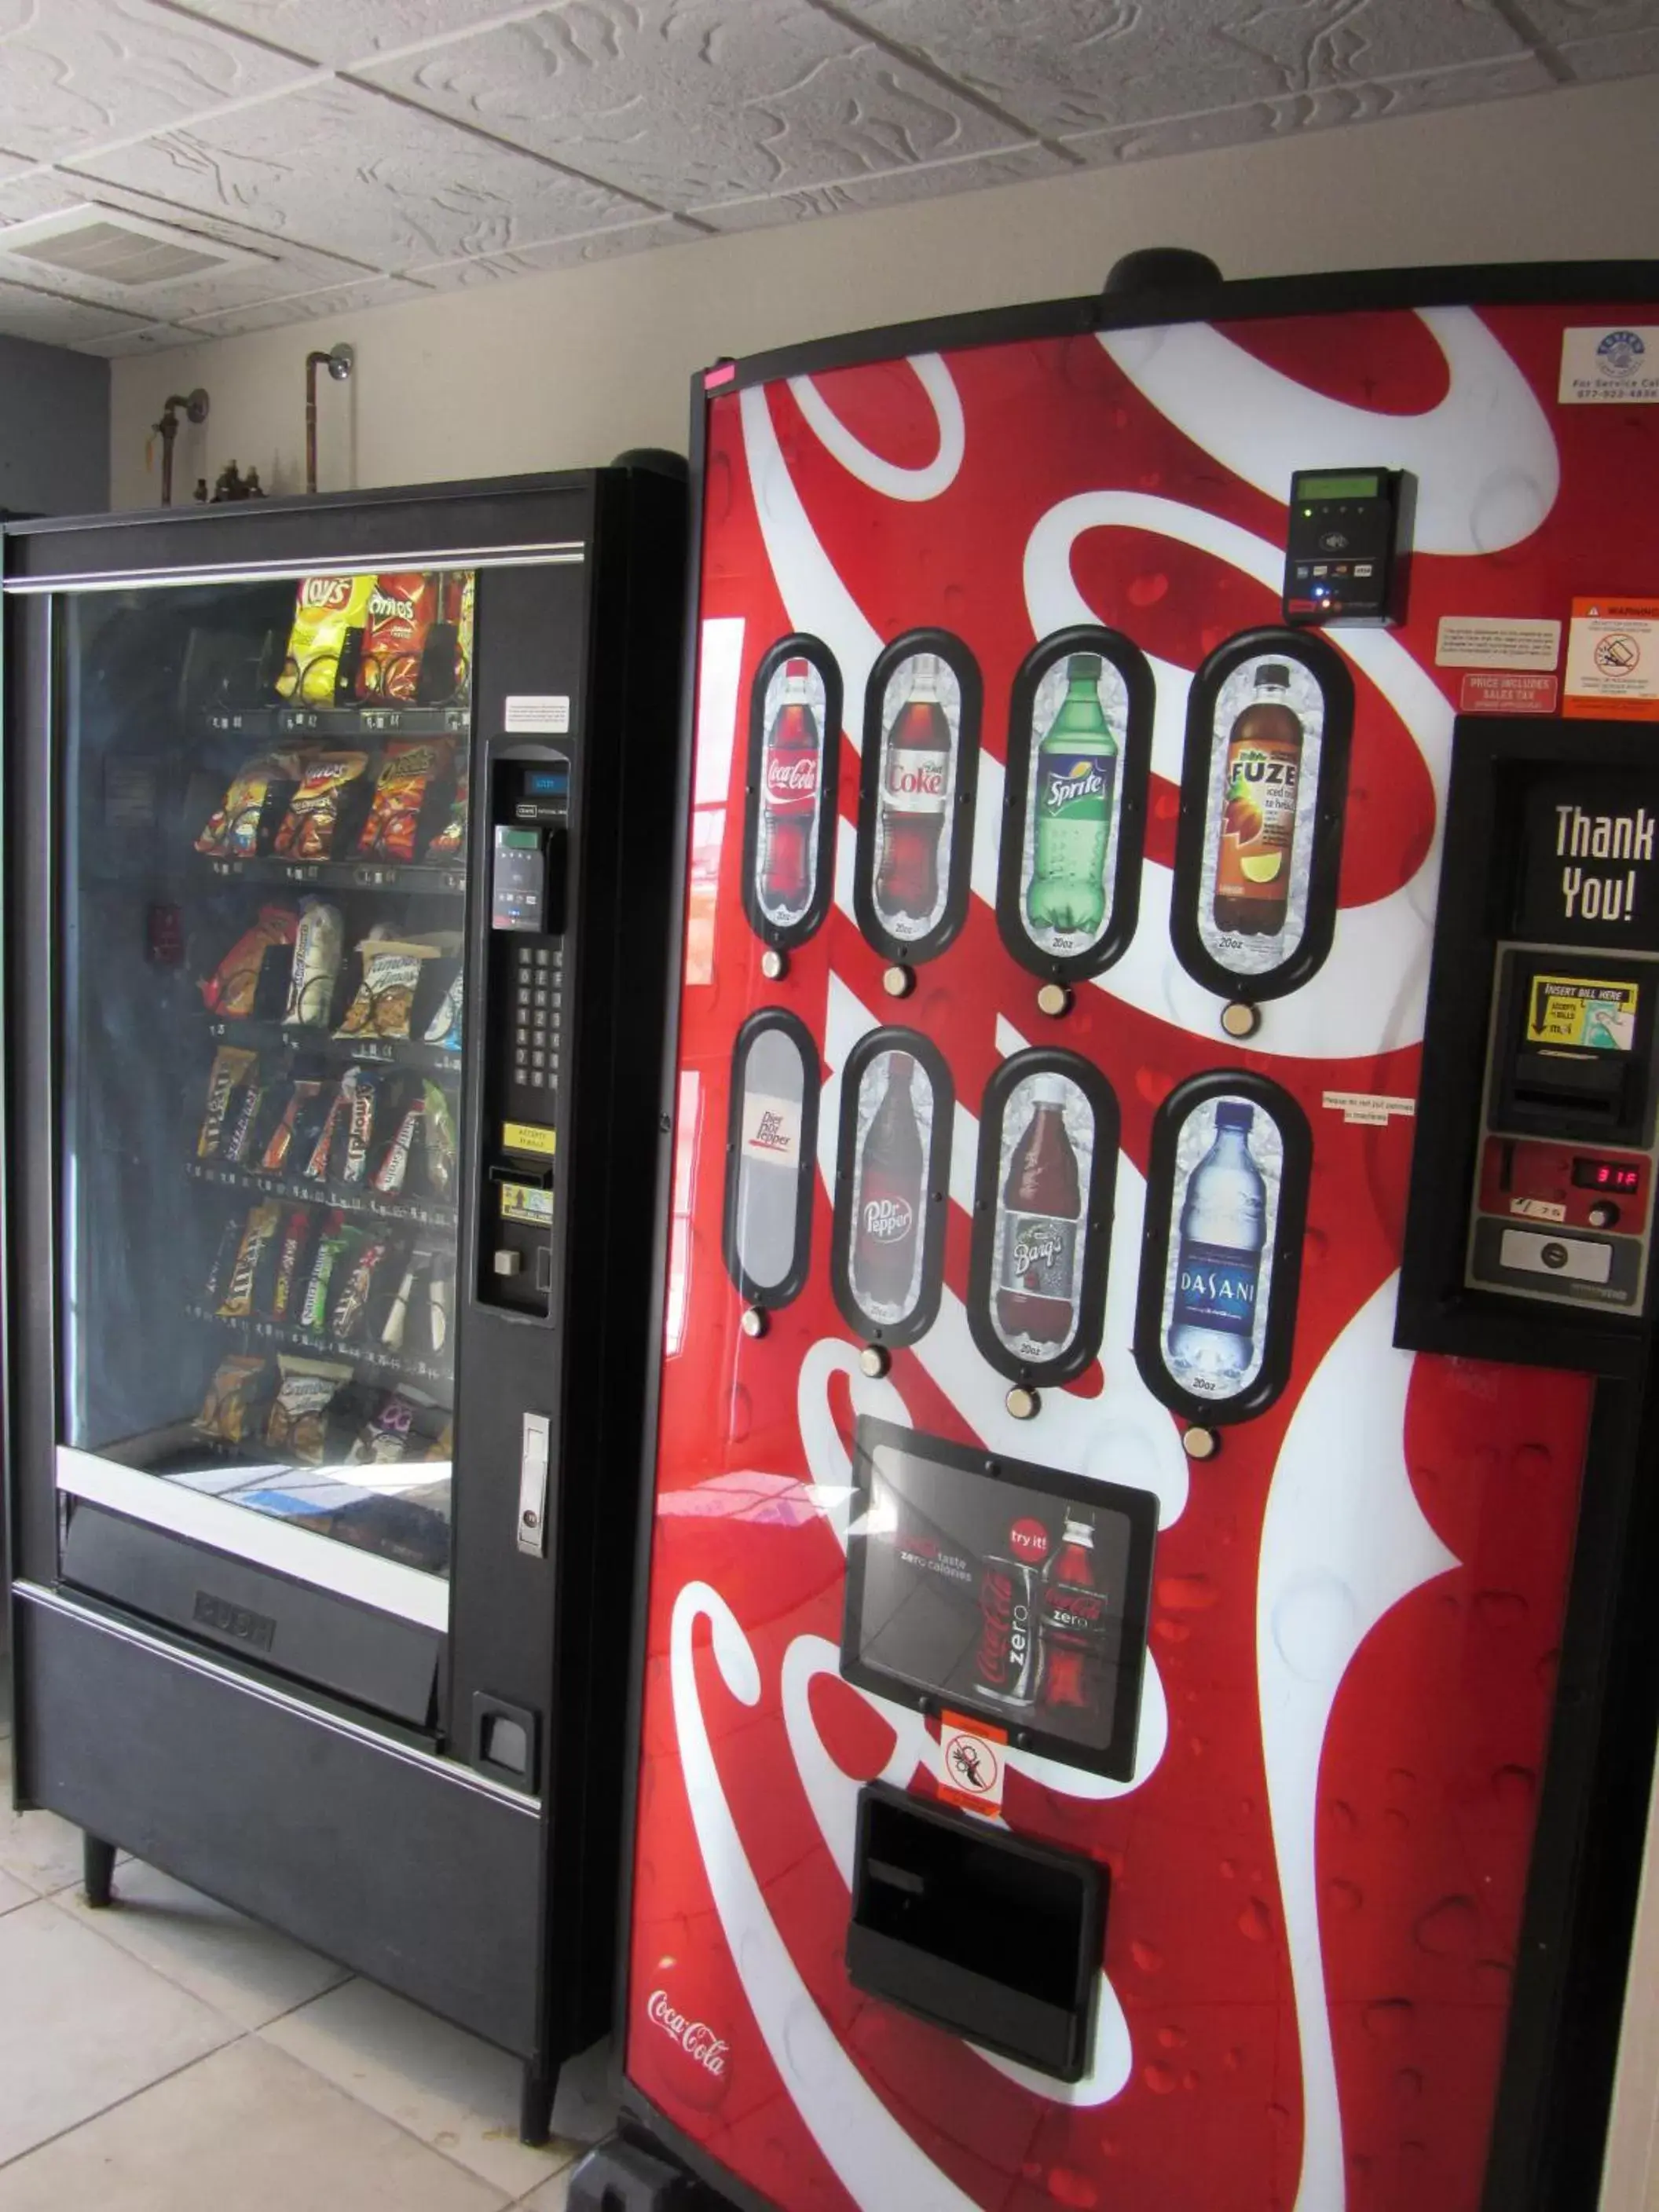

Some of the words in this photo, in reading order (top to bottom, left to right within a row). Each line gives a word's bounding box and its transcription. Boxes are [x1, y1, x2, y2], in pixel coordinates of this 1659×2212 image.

[1470, 677, 1499, 689] PRICE
[1516, 690, 1535, 701] TAX
[767, 758, 816, 792] Coca-Cola
[889, 765, 942, 795] Coke
[1231, 761, 1297, 786] FUZE
[1047, 773, 1104, 808] Sprite
[1555, 805, 1655, 860] Thank
[1562, 866, 1636, 921] You!
[1218, 936, 1243, 950] 20oz
[1544, 983, 1575, 997] INSERT
[1577, 987, 1597, 999] BILL
[1599, 990, 1624, 1001] HERE
[864, 1200, 911, 1233] Pepper
[879, 1199, 900, 1217] Dr
[1014, 1239, 1062, 1274] Barq's
[1180, 1271, 1254, 1302] DASANI
[1192, 1377, 1216, 1391] 20oz
[1009, 1529, 1031, 1549] try
[1032, 1534, 1047, 1551] it!
[899, 1551, 927, 1569] zero
[927, 1558, 972, 1582] calories
[936, 1551, 968, 1569] taste
[975, 1573, 1012, 1685] Coca-Cola
[1053, 1610, 1088, 1628] zero
[1009, 1605, 1028, 1664] zero
[647, 1990, 729, 2076] Coca-Cola
